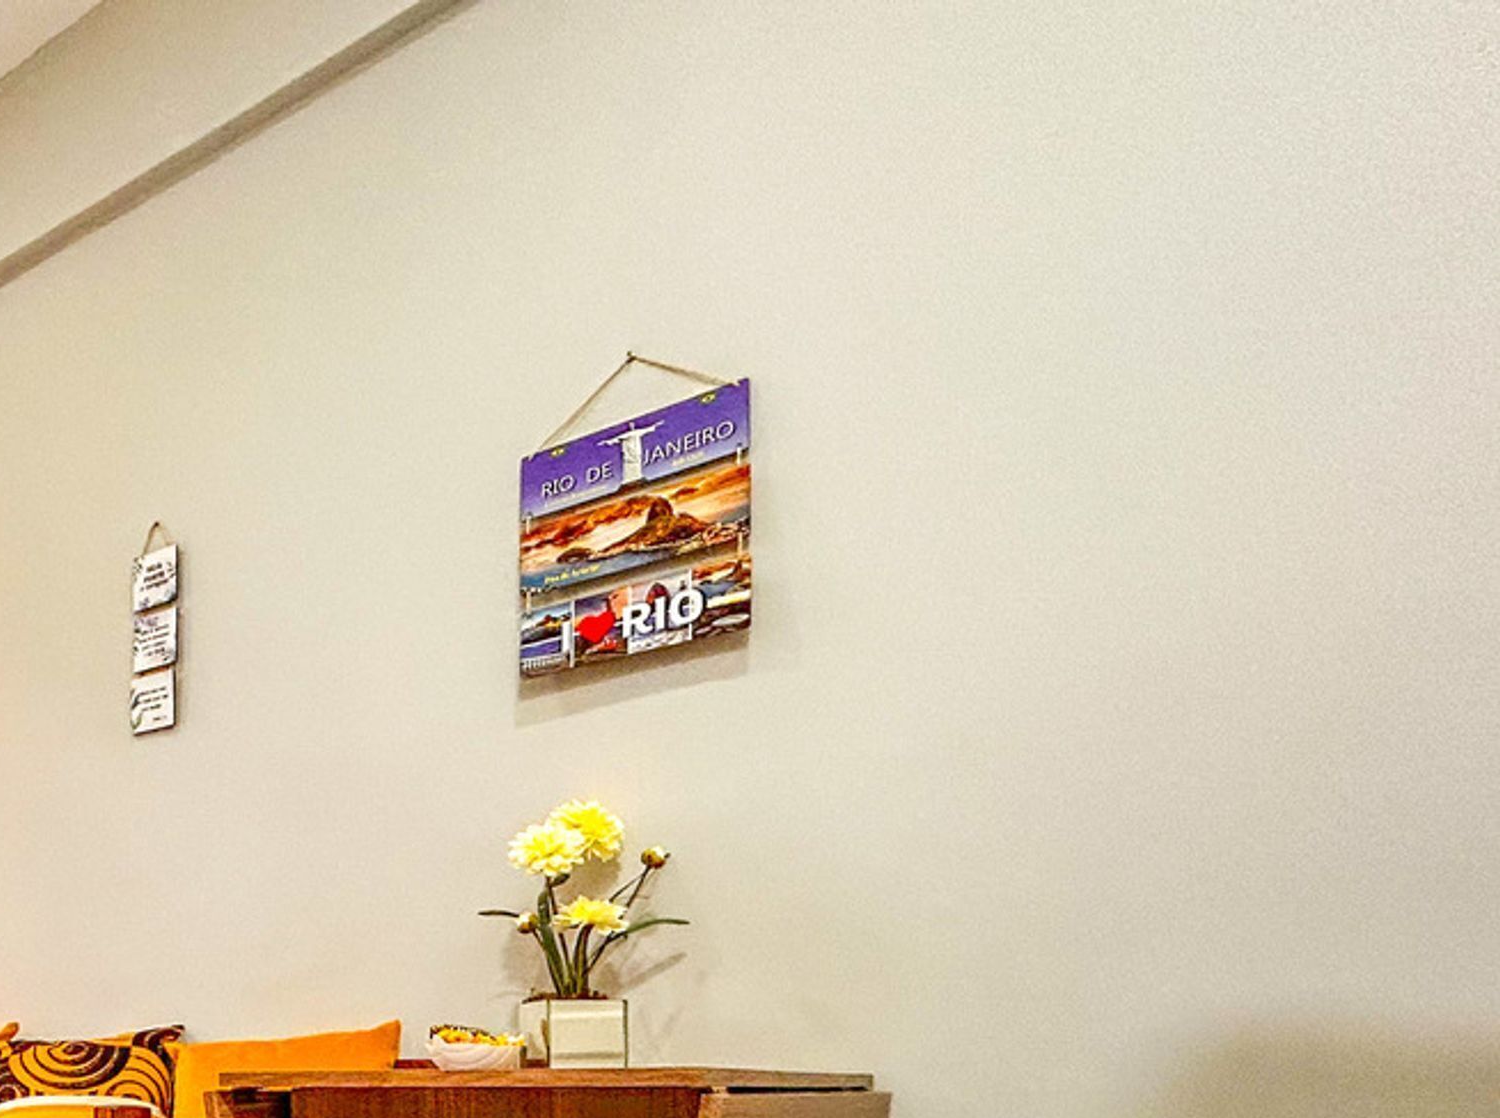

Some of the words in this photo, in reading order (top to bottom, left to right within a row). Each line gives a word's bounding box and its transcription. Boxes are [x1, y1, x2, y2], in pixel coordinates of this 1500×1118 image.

[541, 474, 575, 498] RIO
[586, 460, 614, 485] DE
[643, 421, 735, 466] JANEIRO
[561, 621, 571, 652] I
[621, 588, 703, 639] RIO
